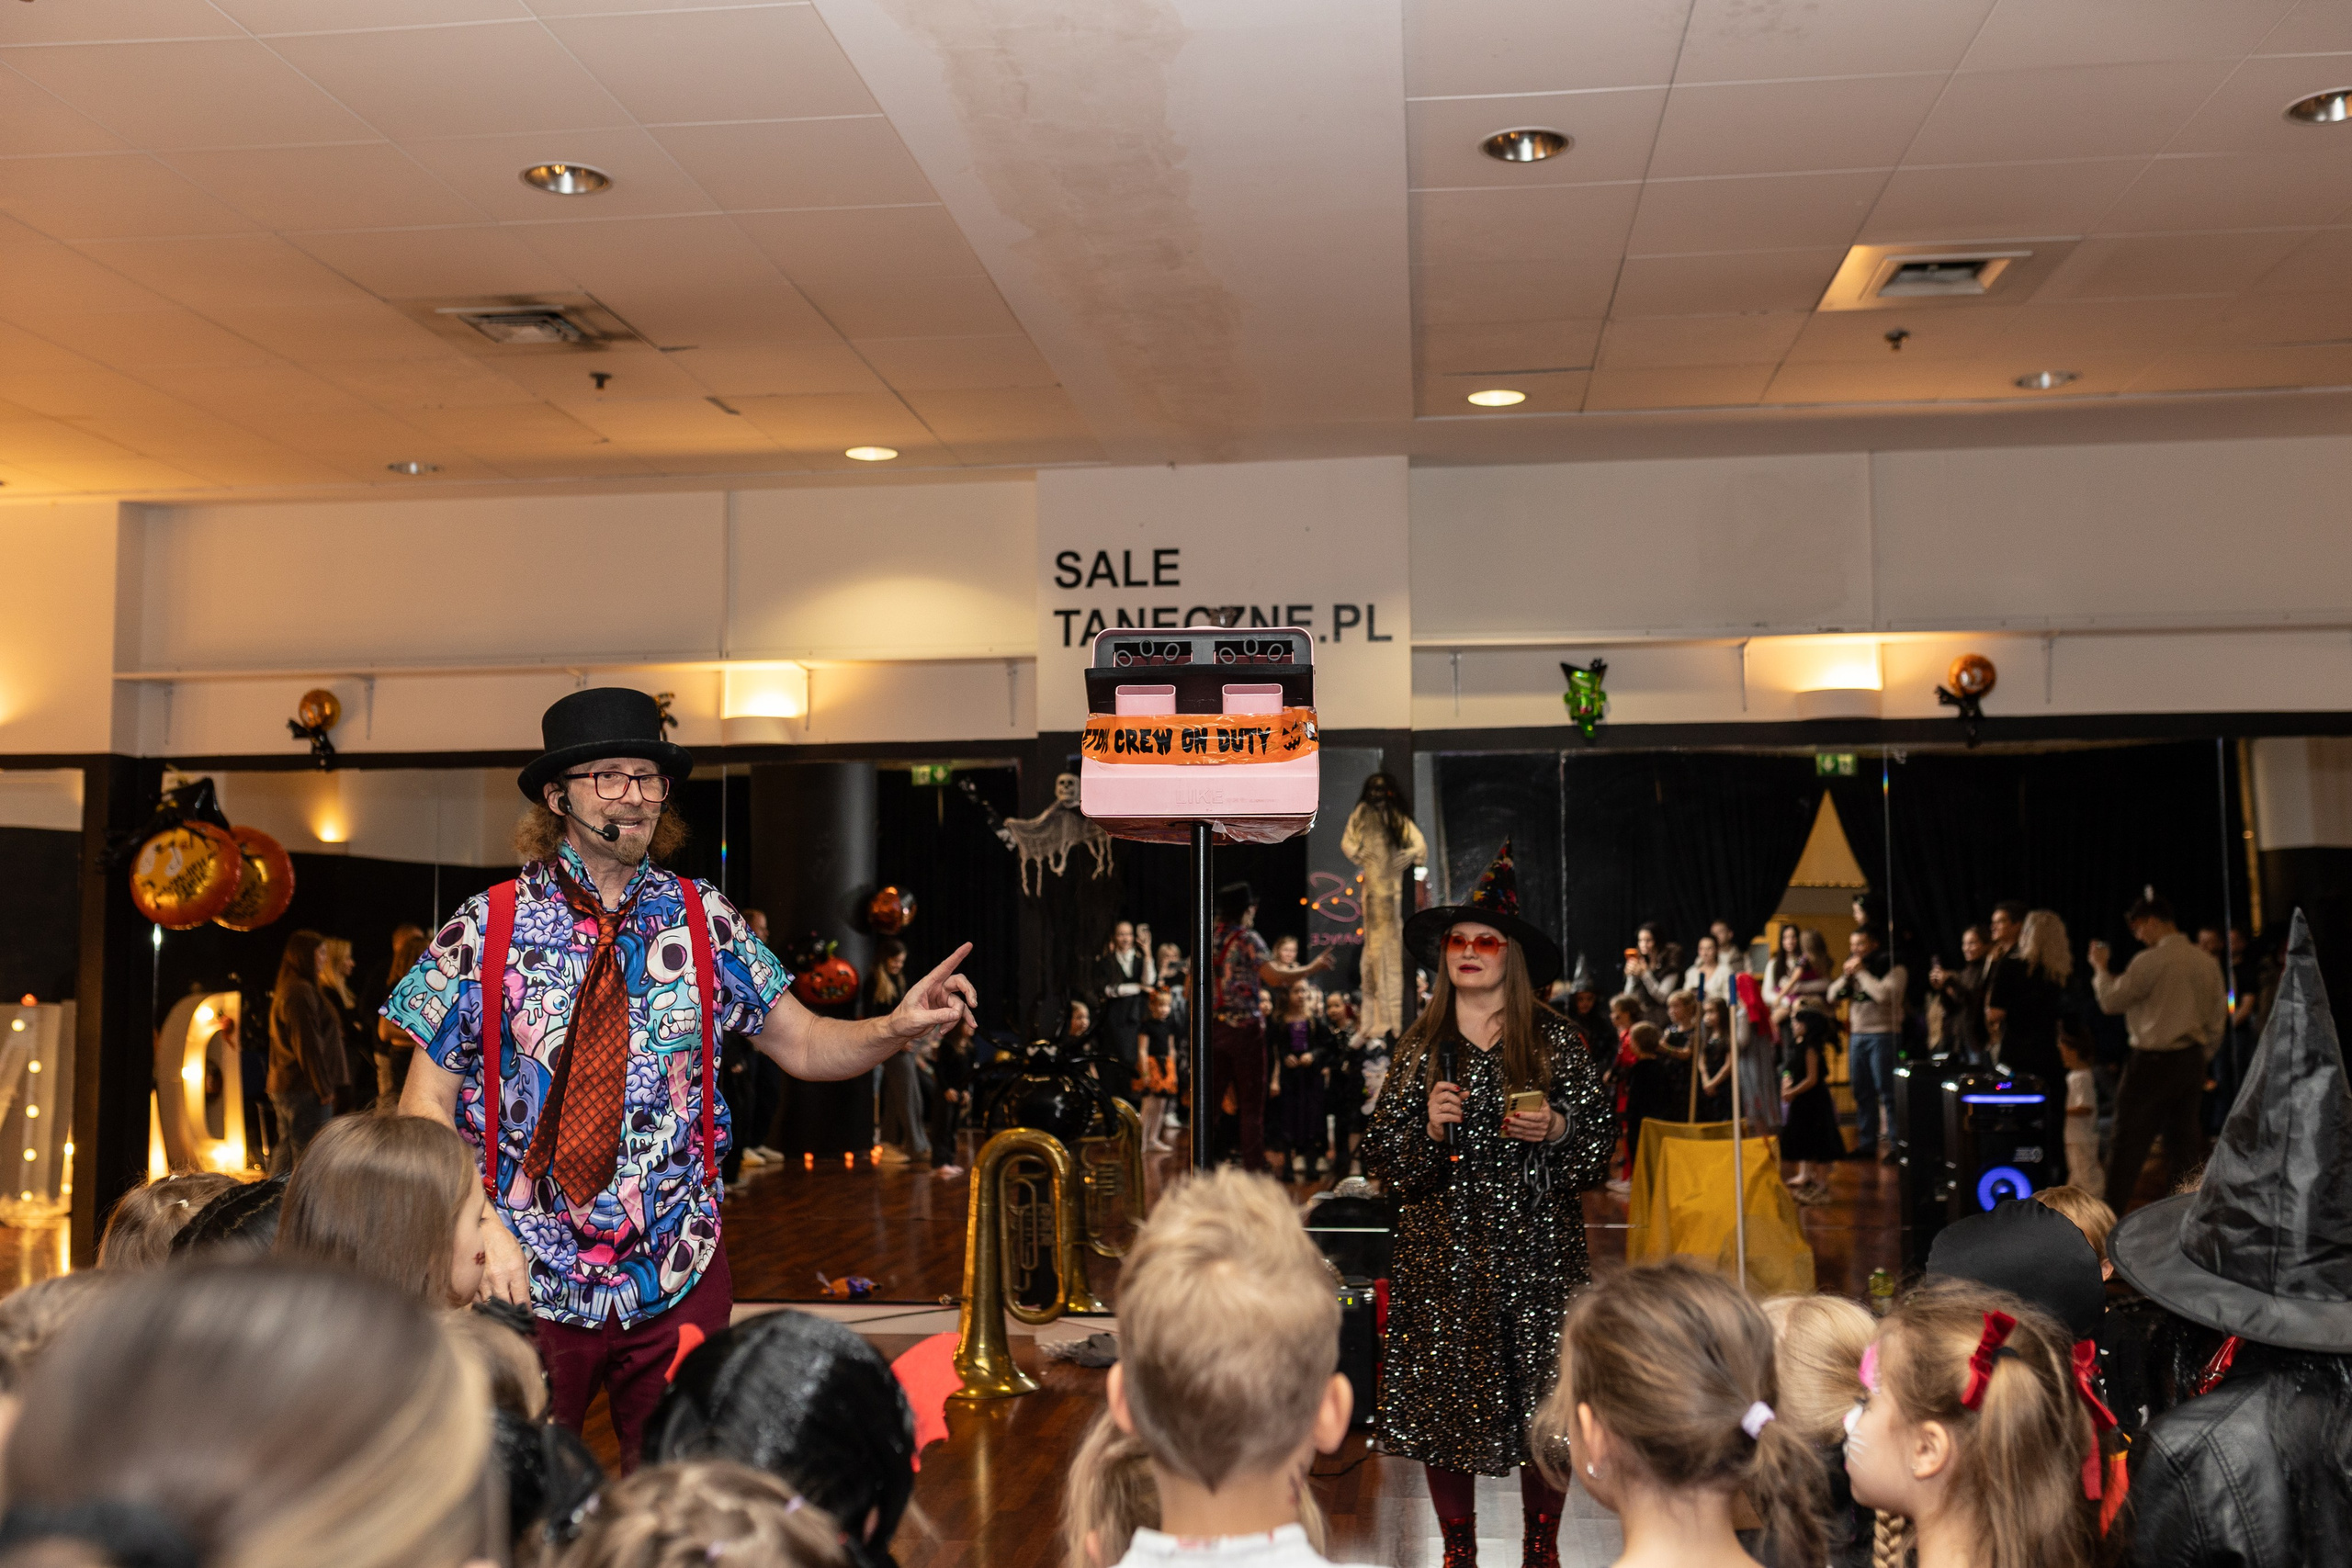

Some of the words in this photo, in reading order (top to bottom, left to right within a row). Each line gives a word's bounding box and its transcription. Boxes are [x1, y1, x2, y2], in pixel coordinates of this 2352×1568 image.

[1055, 548, 1180, 588] SALE
[1114, 728, 1172, 755] CREW
[1182, 728, 1208, 754] ON
[1216, 727, 1271, 755] DUTY
[1176, 788, 1224, 804] LIKE
